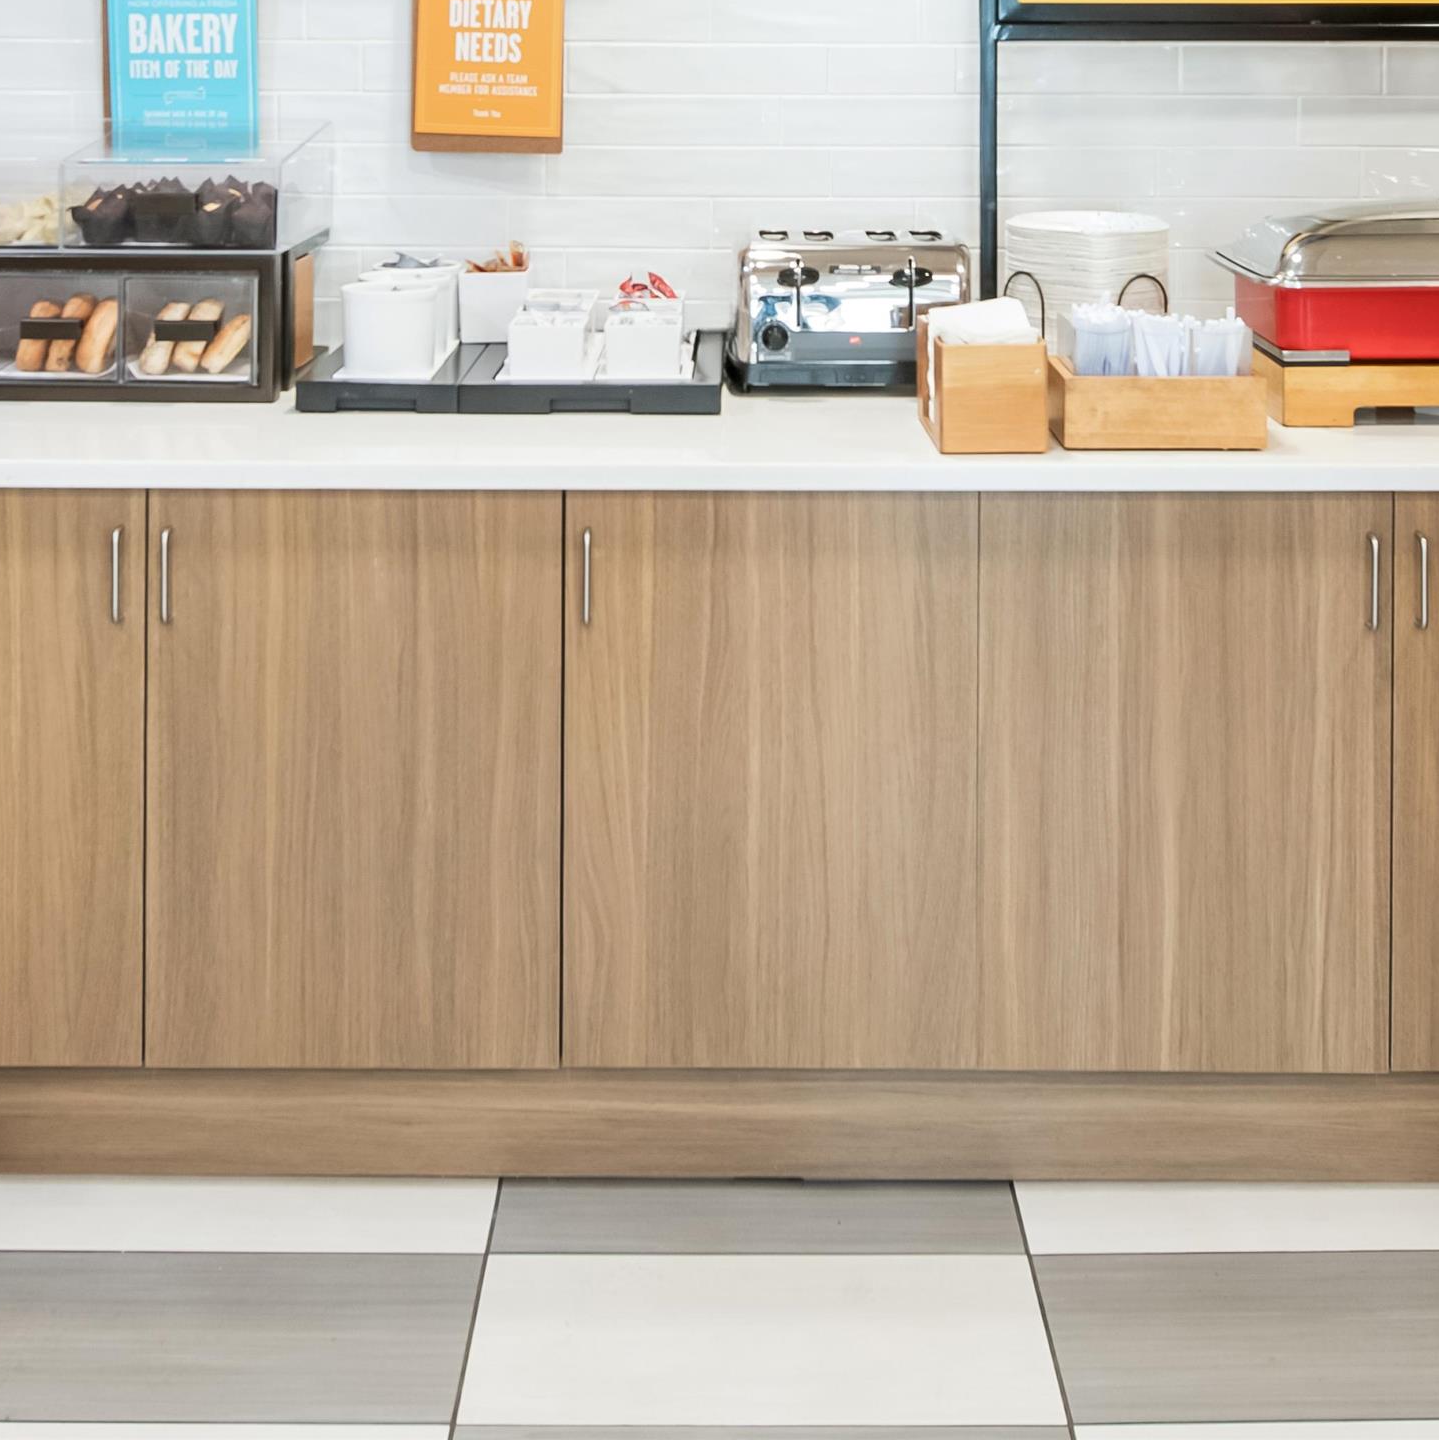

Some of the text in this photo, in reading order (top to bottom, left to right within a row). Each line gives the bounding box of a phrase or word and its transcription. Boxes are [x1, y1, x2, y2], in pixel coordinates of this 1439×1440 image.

[128, 13, 238, 54] BAKERY
[455, 31, 522, 64] NEEDS
[129, 60, 239, 79] ITEM OF THE DAY
